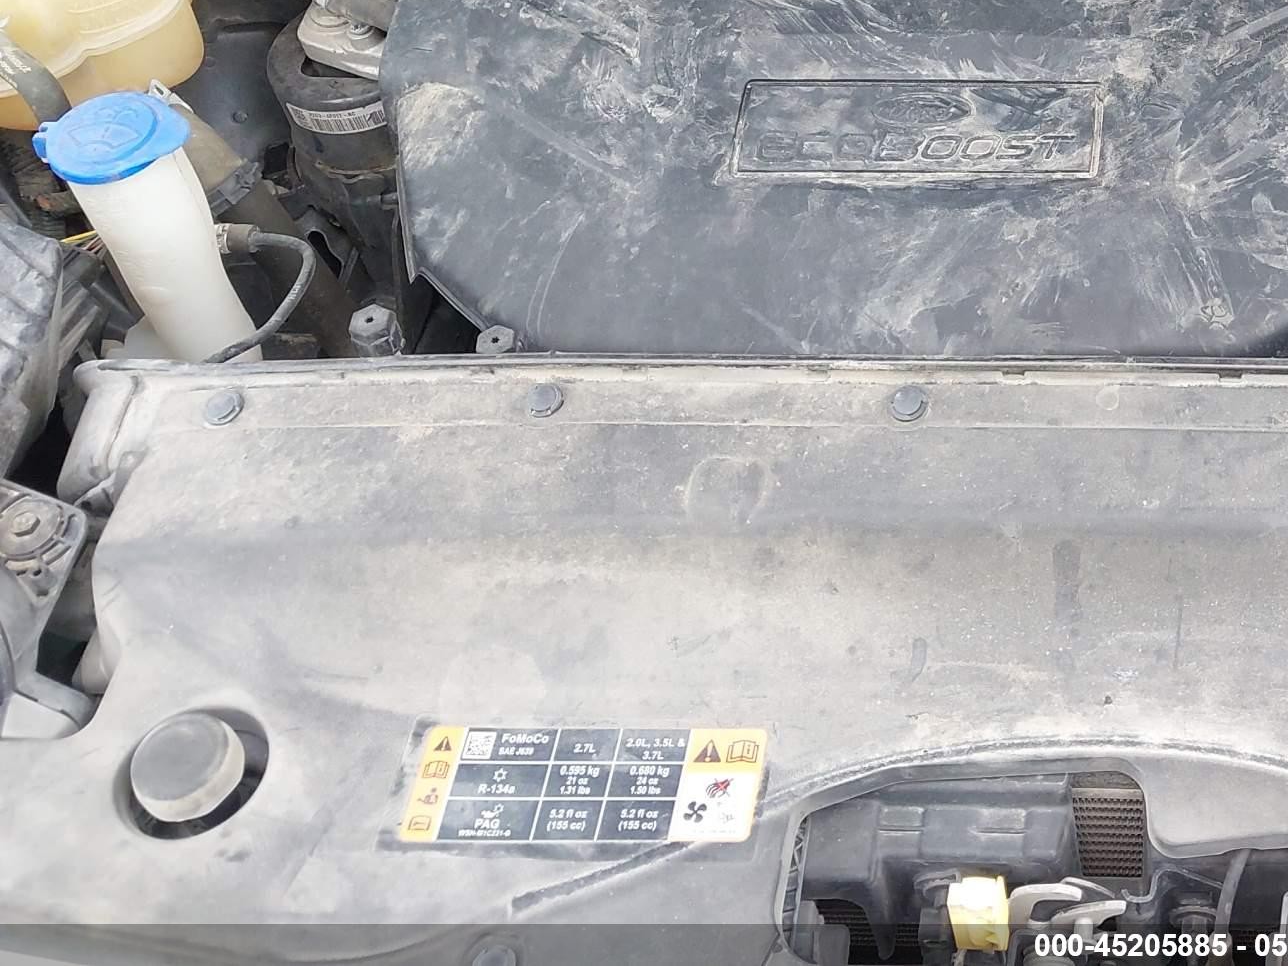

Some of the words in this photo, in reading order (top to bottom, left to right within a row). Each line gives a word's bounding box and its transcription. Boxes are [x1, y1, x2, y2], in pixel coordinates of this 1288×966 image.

[501, 733, 549, 745] FoMoCo
[626, 738, 651, 748] 2.0L,
[653, 738, 674, 747] 3.5L
[677, 738, 686, 747] &
[498, 747, 515, 756] SAE
[573, 743, 596, 753] 2.7L
[642, 751, 664, 761] 3.7L
[560, 765, 586, 776] 0.595
[587, 765, 600, 777] kg
[630, 765, 656, 776] 0.680
[657, 765, 670, 777] kg
[566, 777, 576, 785] 21
[636, 777, 647, 785] 24
[477, 783, 515, 794] R-134a
[560, 786, 576, 795] 1.31
[577, 786, 590, 795] lbs
[630, 786, 646, 795] 1.50
[648, 786, 661, 795] lbs
[549, 809, 564, 819] 5.2
[565, 809, 574, 818] fl
[620, 809, 636, 819] 5.2
[637, 809, 645, 818] fl
[474, 818, 500, 829] PAG
[546, 820, 569, 832] (155
[570, 820, 586, 832] cc)
[618, 820, 640, 832] (155
[641, 820, 657, 832] cc)
